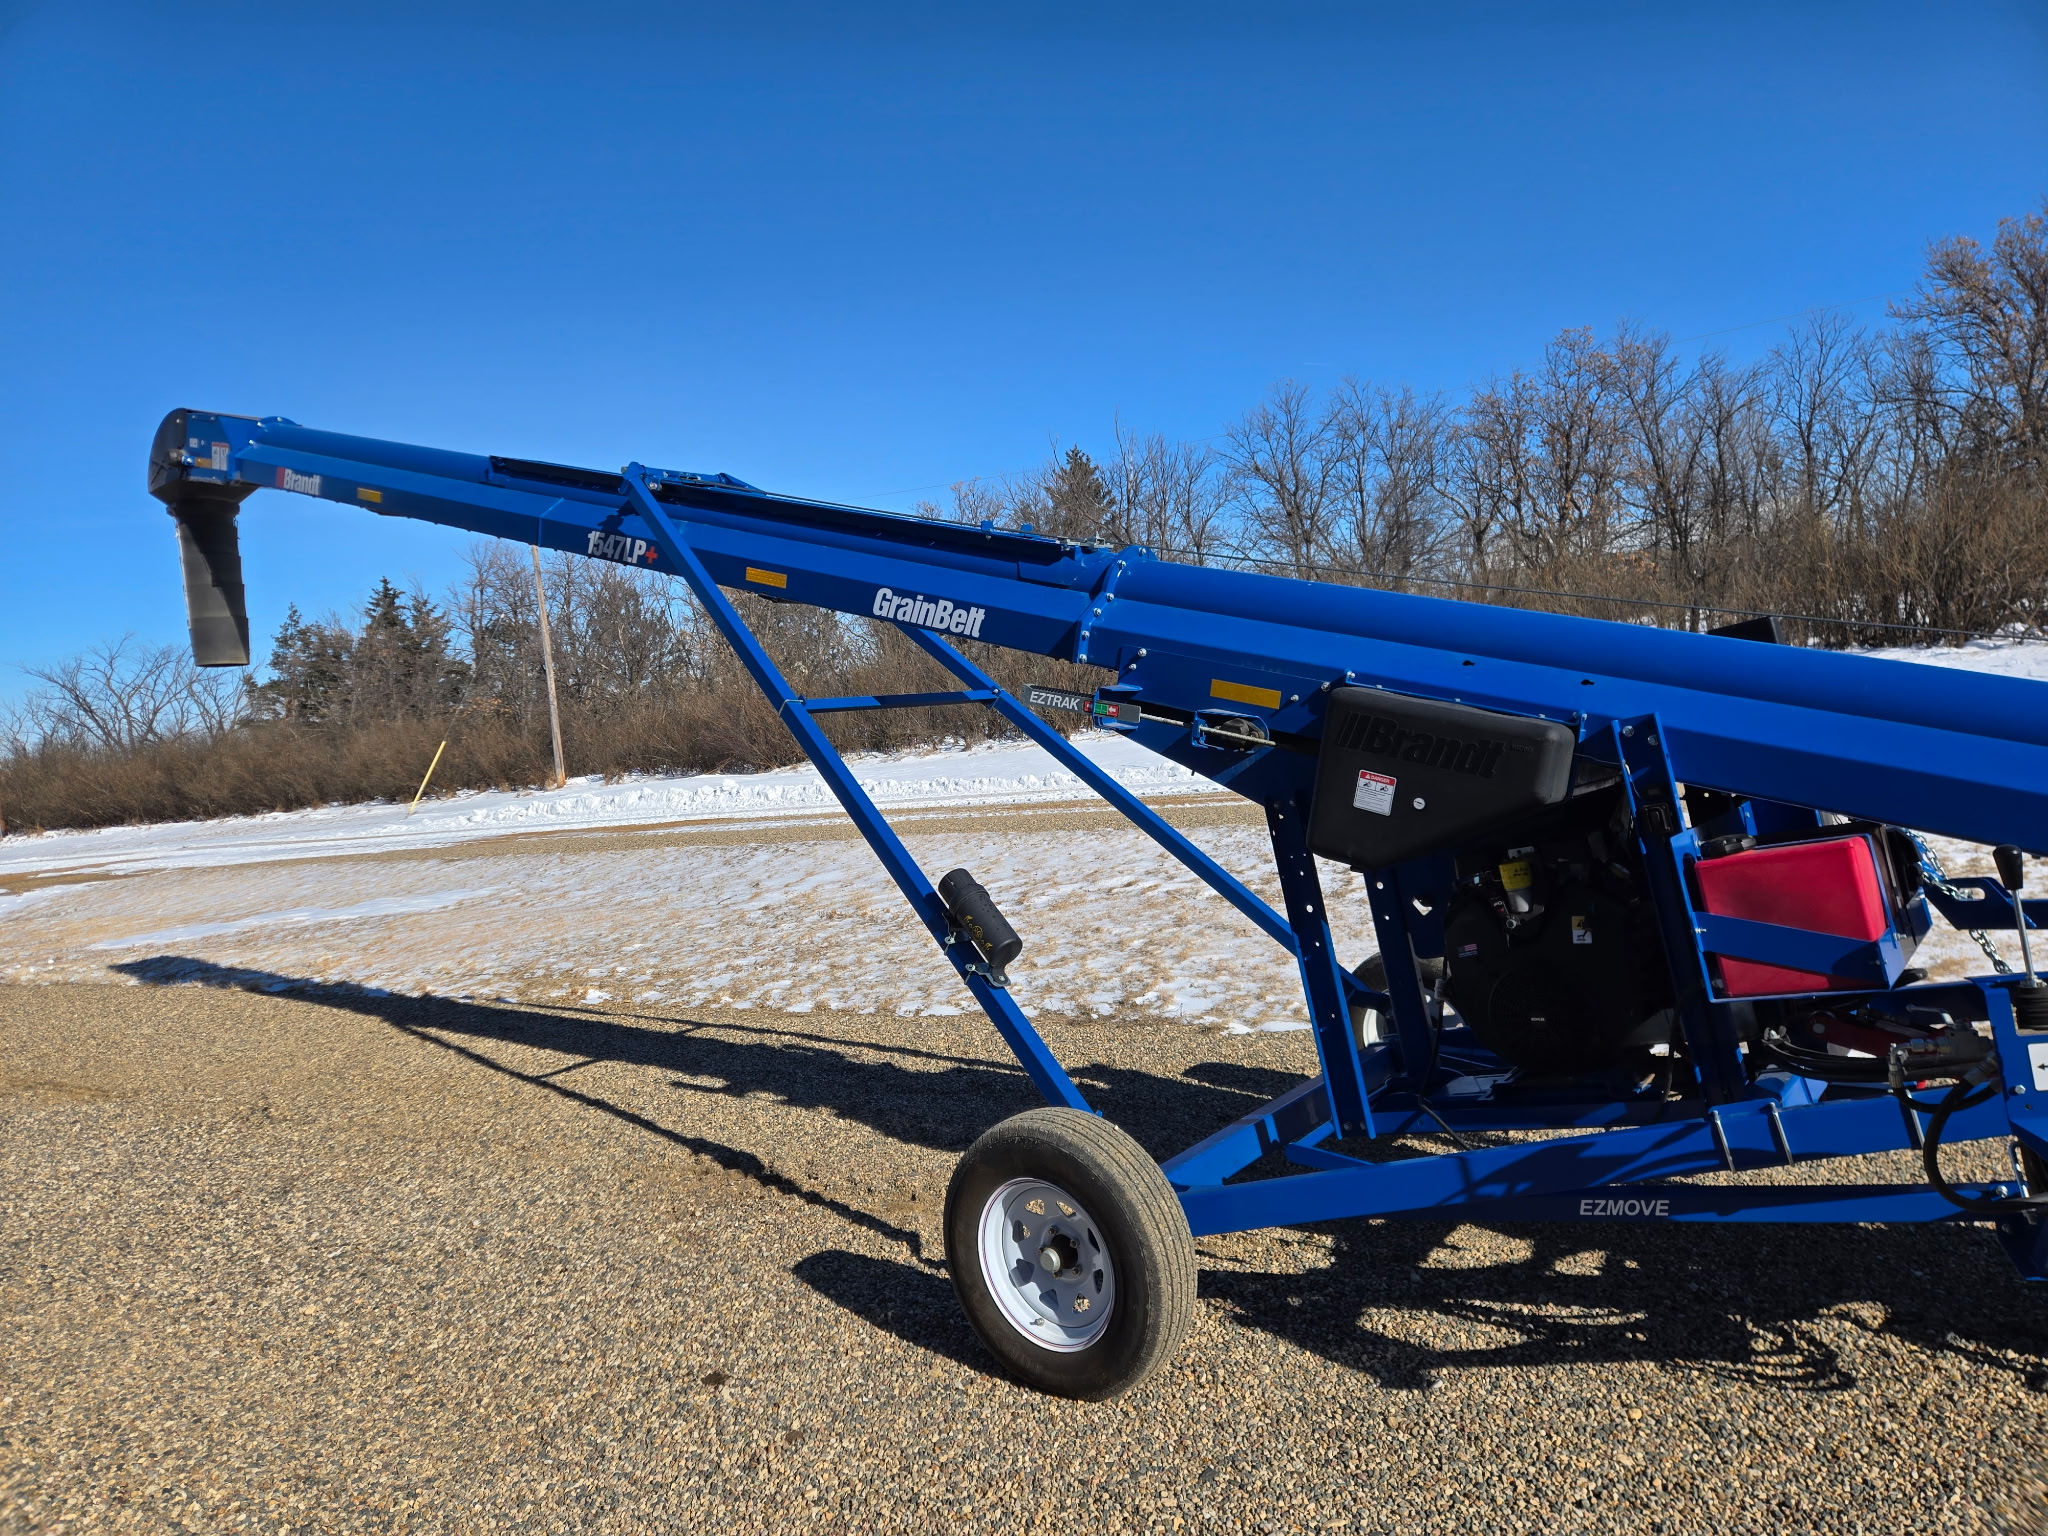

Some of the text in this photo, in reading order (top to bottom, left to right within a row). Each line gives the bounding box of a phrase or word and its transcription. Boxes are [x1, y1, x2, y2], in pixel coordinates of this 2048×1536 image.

[283, 468, 321, 496] Brandt
[872, 587, 986, 638] GrainBelt
[1029, 690, 1081, 711] EZTRAK
[1361, 716, 1505, 777] Brandt
[1370, 774, 1390, 784] DANGER
[1579, 1199, 1670, 1216] EZMOVE
